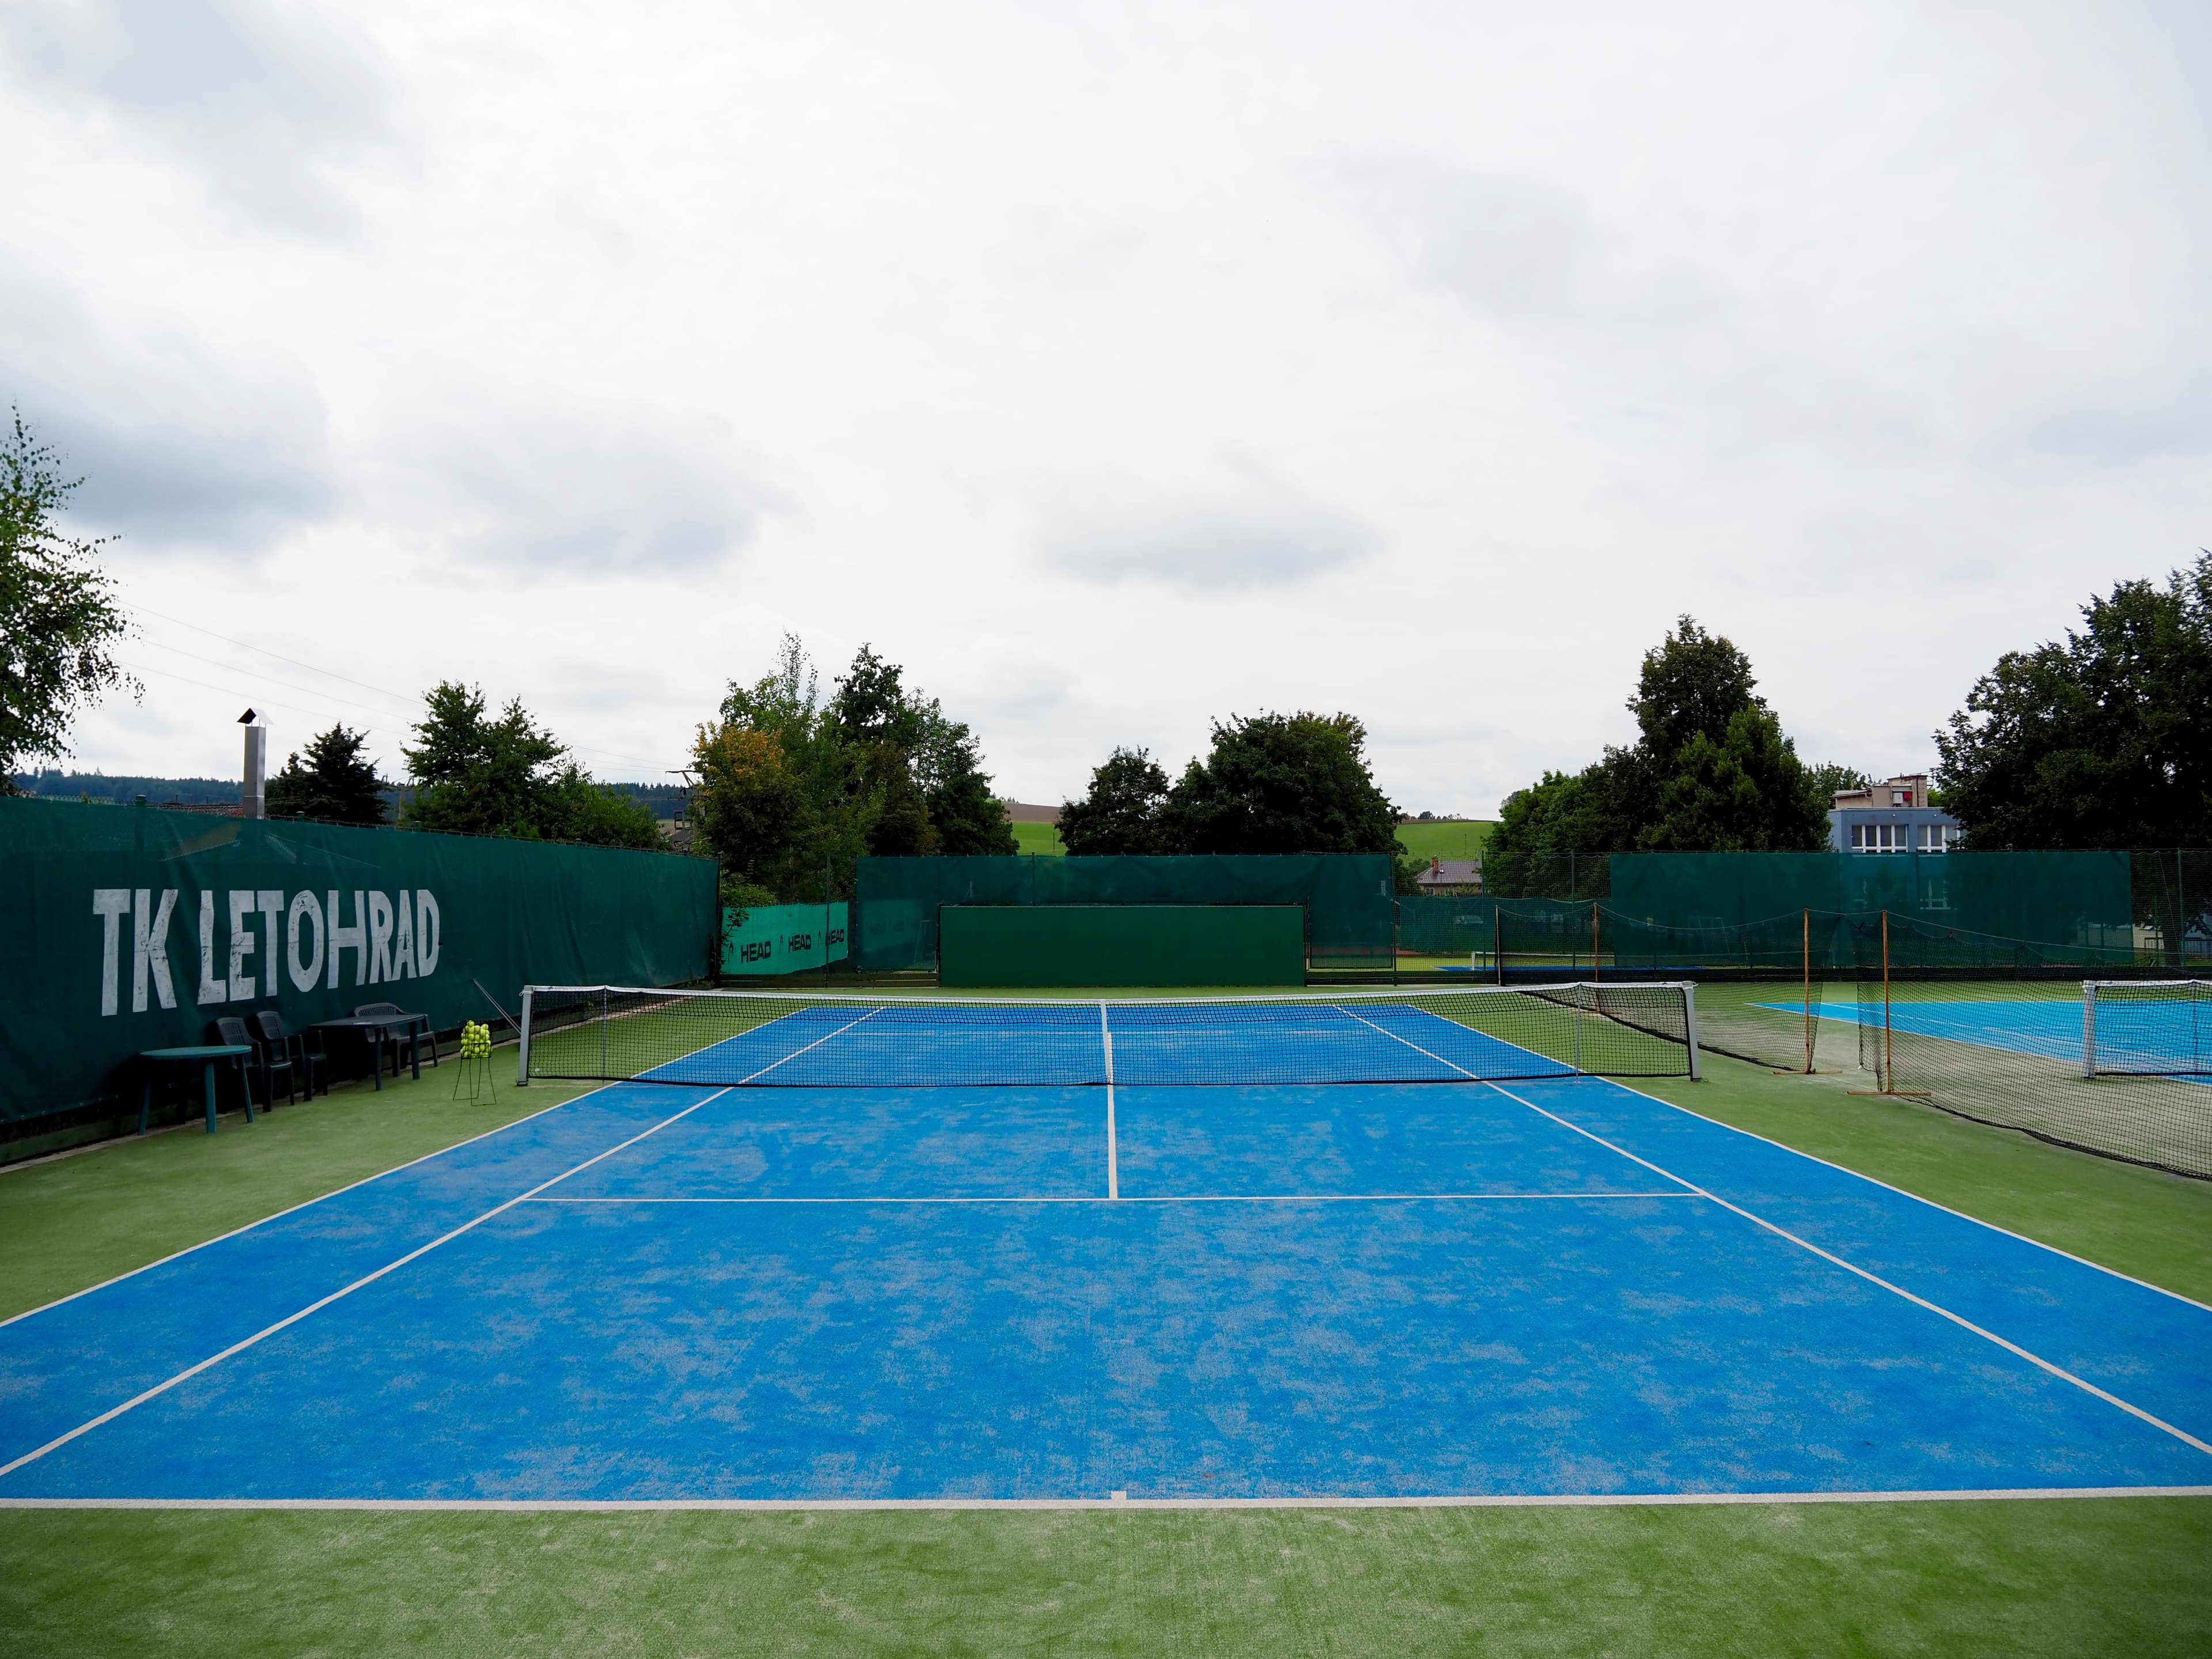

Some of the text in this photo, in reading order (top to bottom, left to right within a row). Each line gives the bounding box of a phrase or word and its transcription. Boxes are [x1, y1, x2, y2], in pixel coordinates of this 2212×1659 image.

[93, 889, 440, 1016] TK LETOHRAD
[741, 941, 771, 963] HEAD
[788, 934, 811, 953] HEAD
